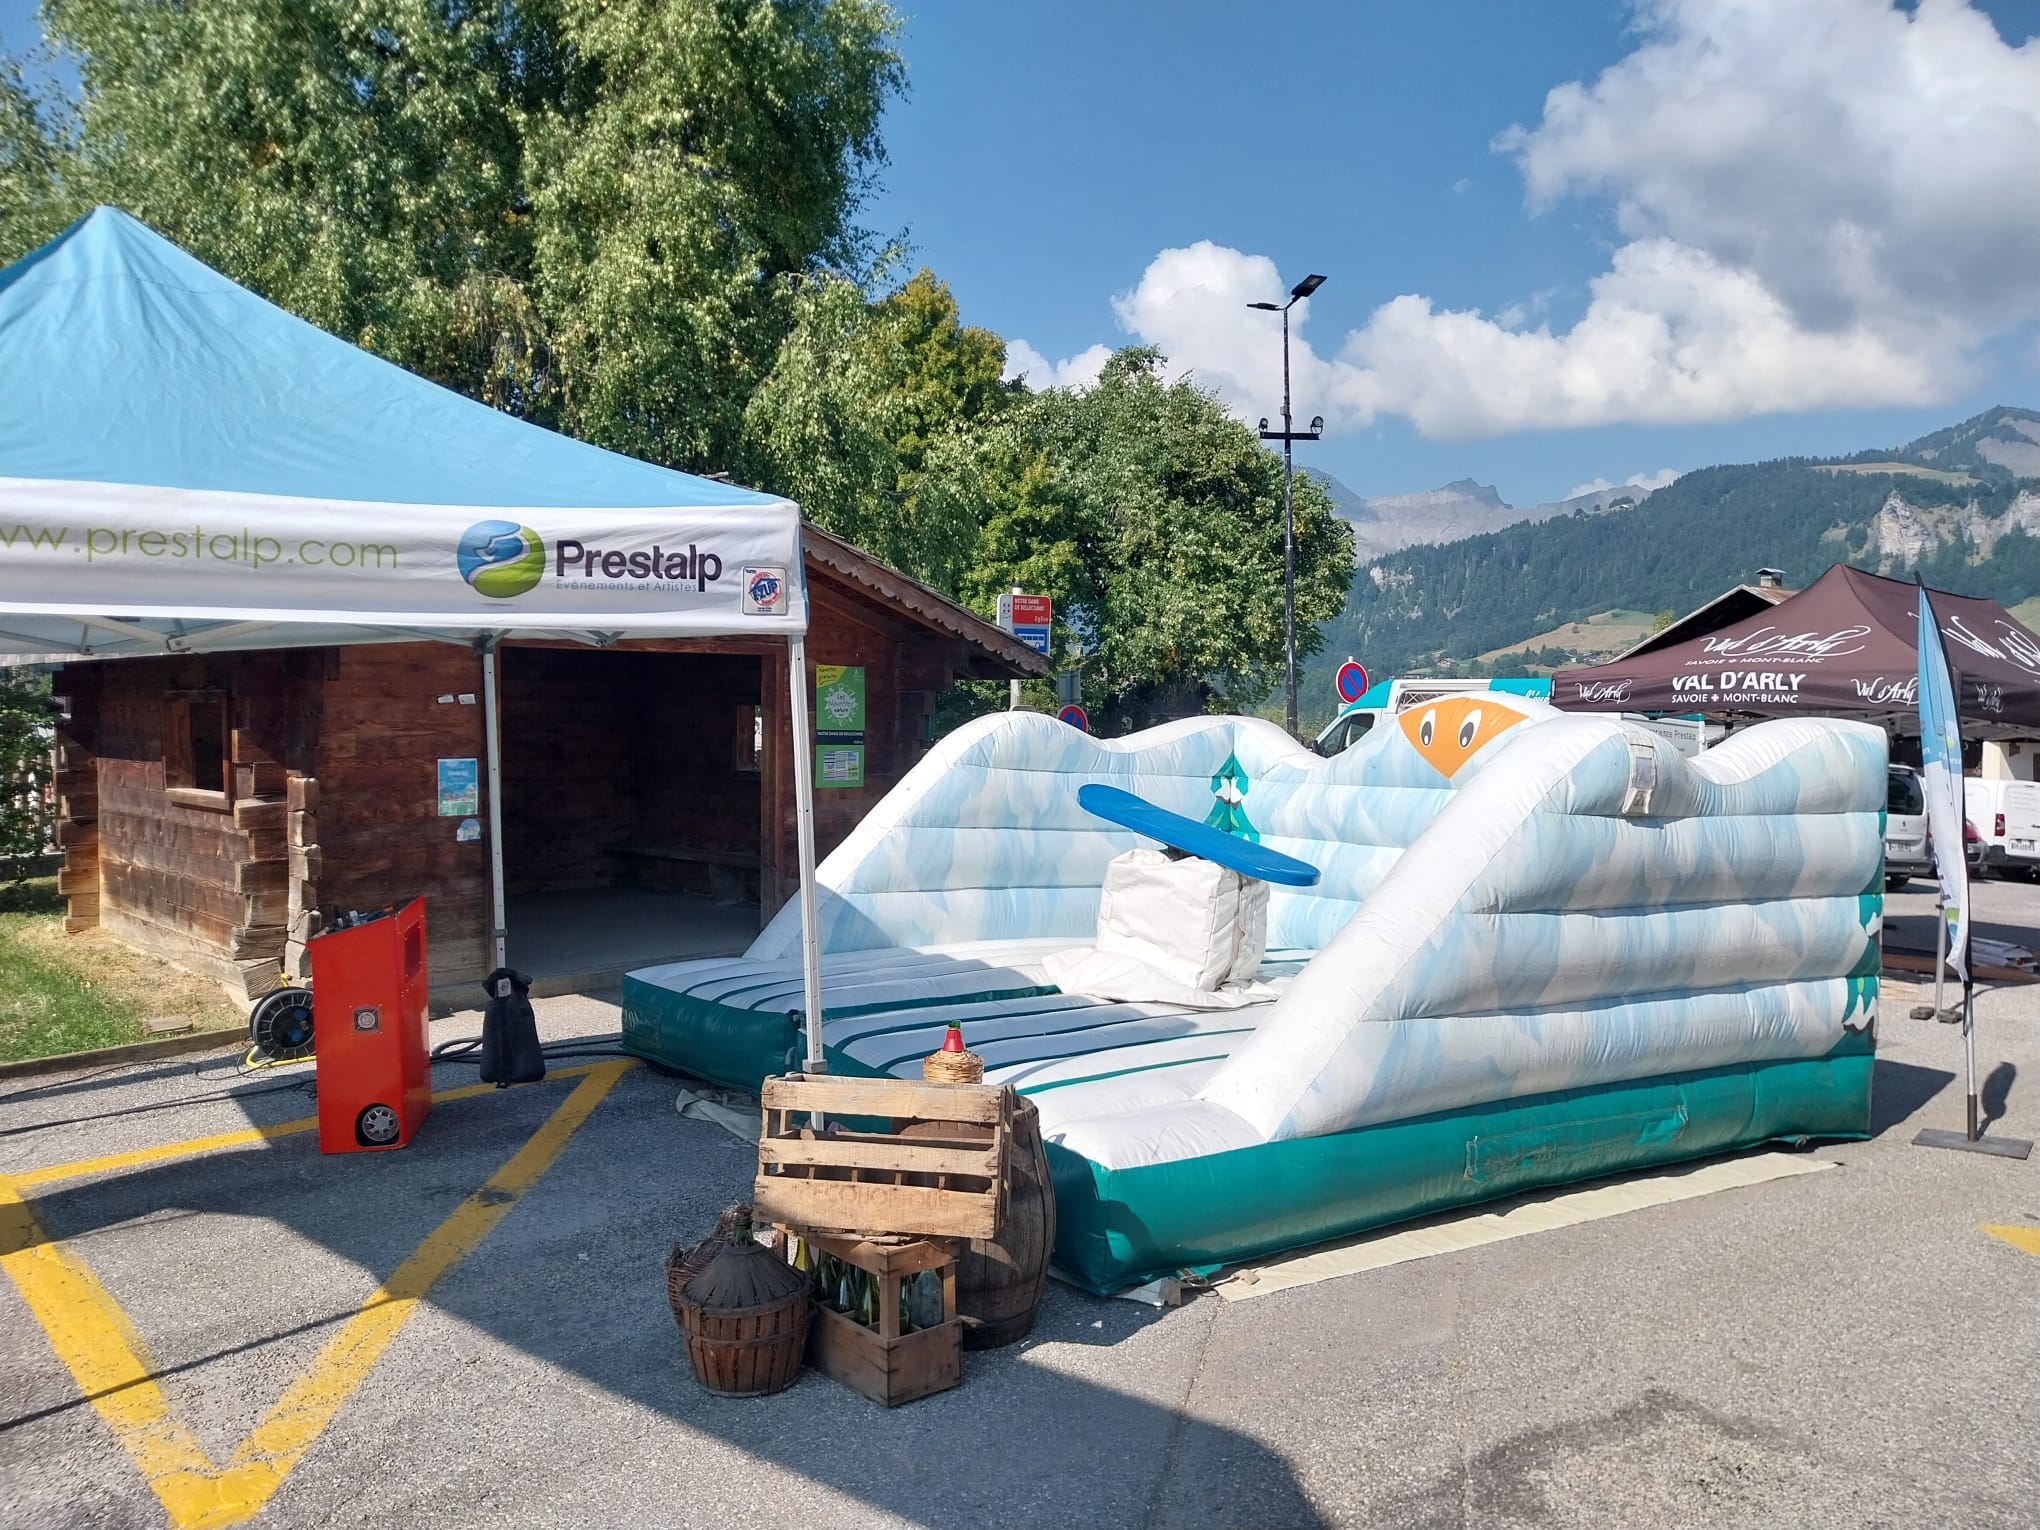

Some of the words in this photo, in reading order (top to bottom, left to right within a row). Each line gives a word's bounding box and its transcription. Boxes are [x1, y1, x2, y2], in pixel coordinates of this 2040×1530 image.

[556, 540, 722, 592] Prestalp
[638, 582, 650, 591] et
[653, 582, 697, 592] Artistes
[1685, 658, 1727, 666] SAVOIE
[1672, 674, 1714, 691] VAL
[1720, 672, 1806, 691] D'ARLY
[1671, 693, 1708, 704] SAVOIE
[1723, 692, 1799, 704] MONT-BLANC
